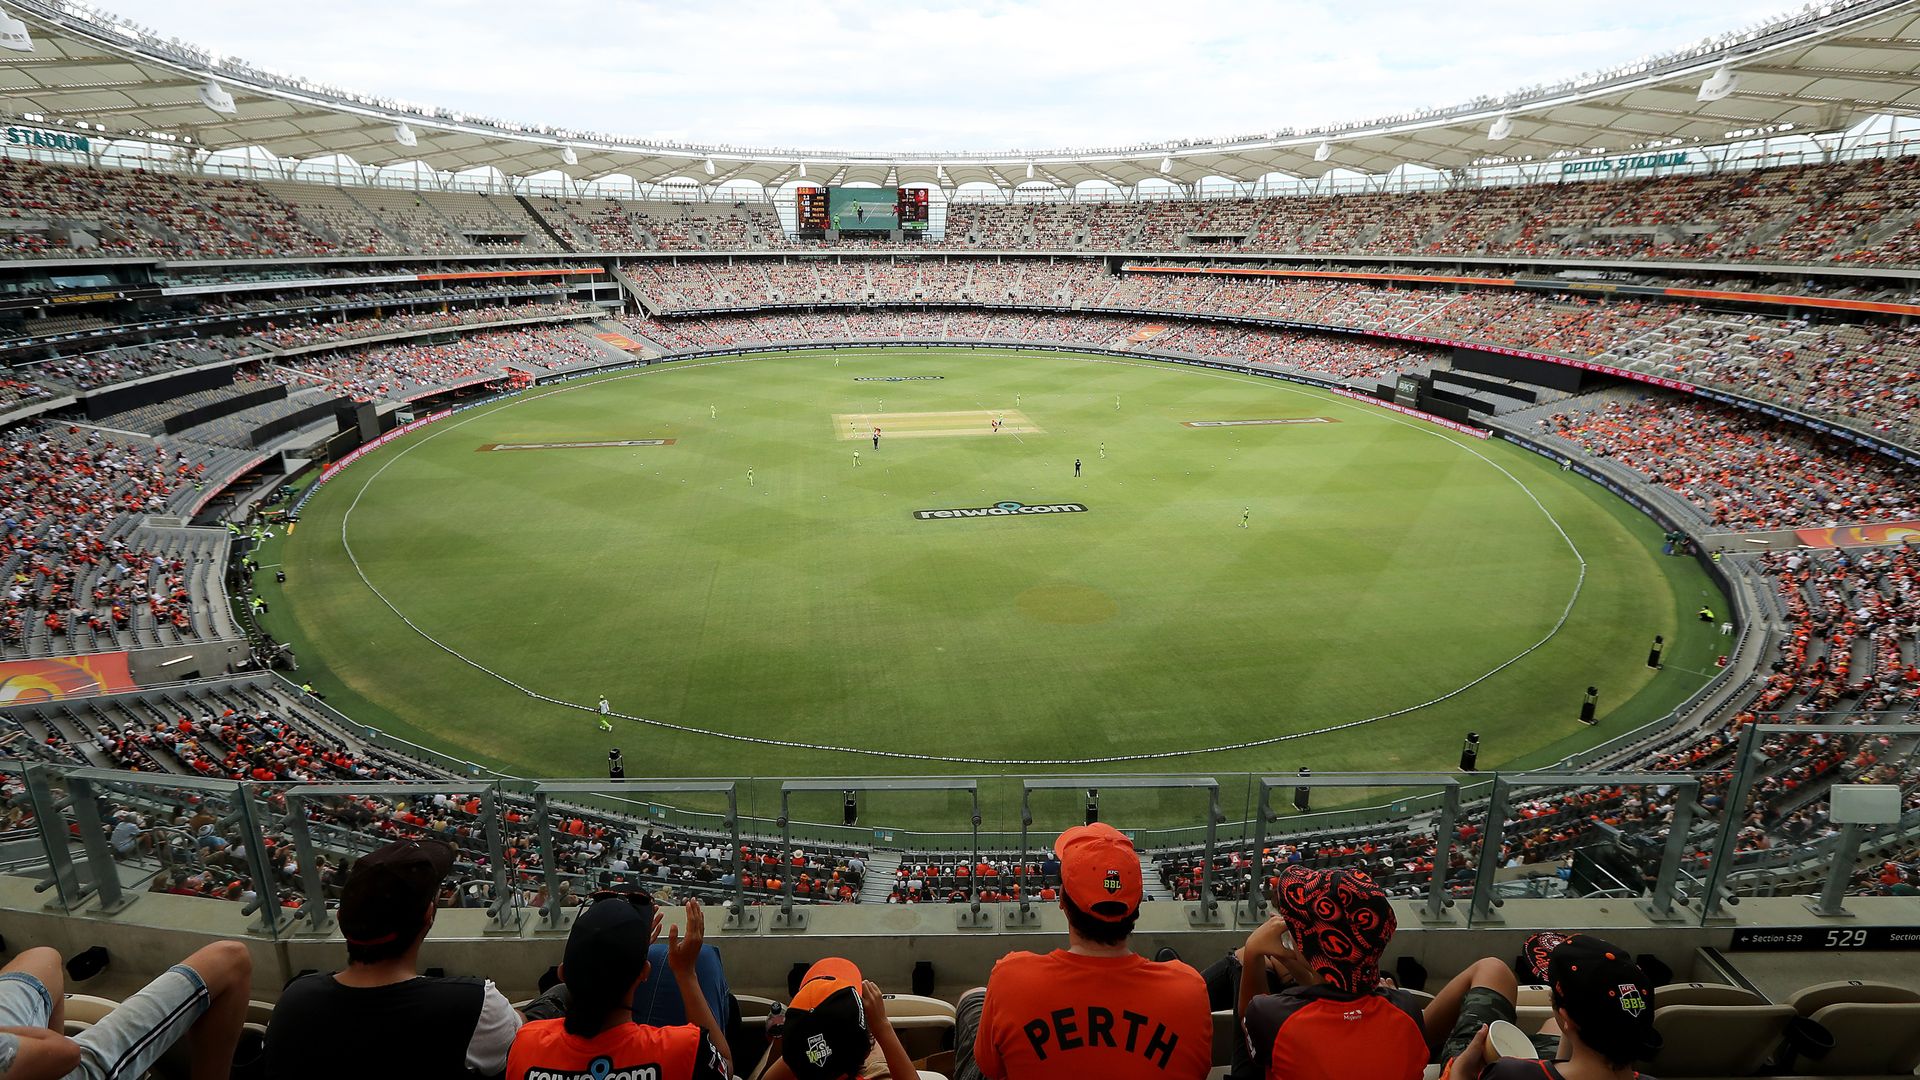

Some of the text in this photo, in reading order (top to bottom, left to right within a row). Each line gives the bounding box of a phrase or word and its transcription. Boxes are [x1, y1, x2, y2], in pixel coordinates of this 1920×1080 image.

[7, 127, 89, 152] STADIUM
[1562, 152, 1686, 174] OPTUS STADIUM
[920, 502, 1083, 519] reiwa.com
[1103, 879, 1121, 889] BBL
[1752, 934, 1803, 943] Section 529
[1824, 930, 1868, 947] 529
[1890, 933, 1920, 941] Section
[1622, 997, 1647, 1009] BBL
[1023, 1006, 1179, 1070] PERTH
